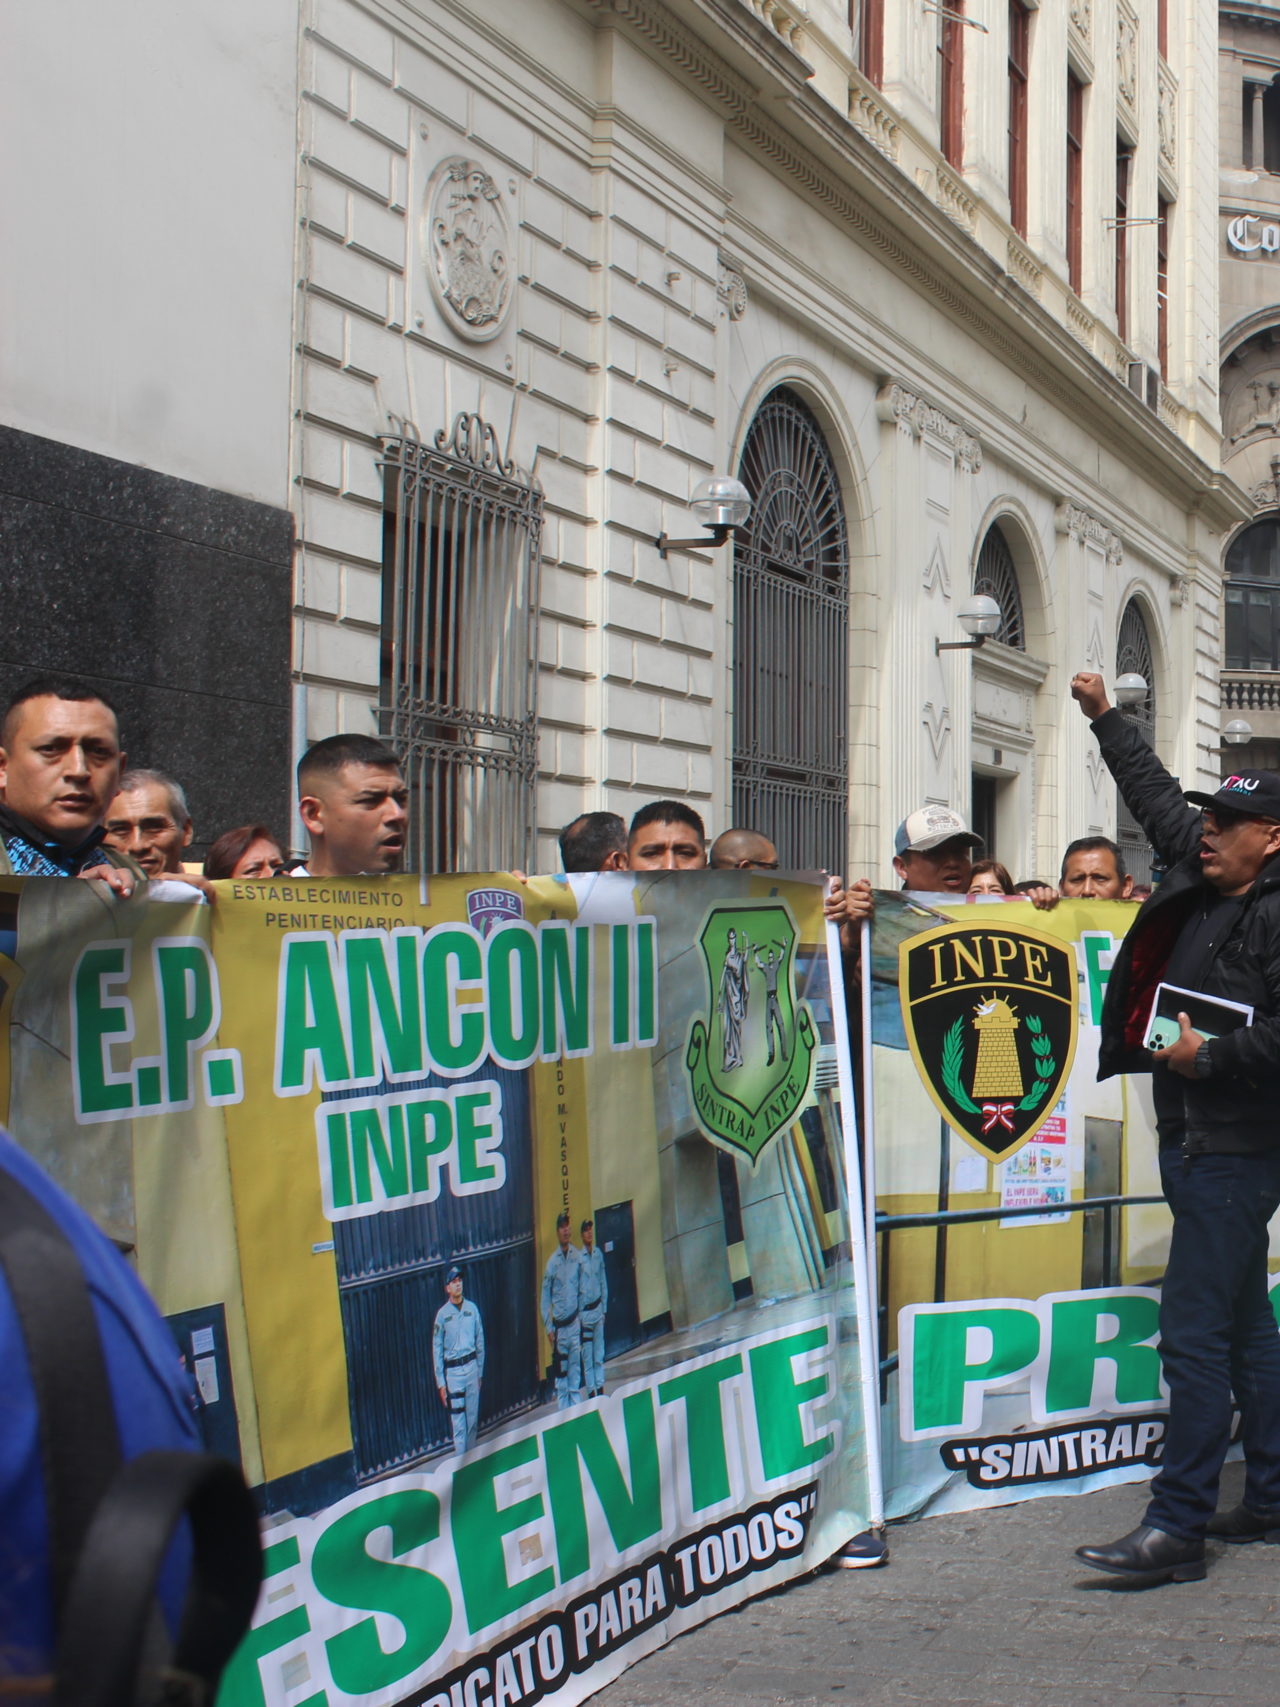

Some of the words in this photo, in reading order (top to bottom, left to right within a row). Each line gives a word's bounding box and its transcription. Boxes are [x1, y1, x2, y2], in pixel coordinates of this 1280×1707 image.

[233, 884, 403, 907] ESTABLECIMIENTO
[265, 912, 405, 931] PENITENCIARIO
[474, 893, 516, 911] INPE
[929, 935, 1053, 989] INPE
[75, 945, 236, 1114] E.P.
[280, 926, 590, 1089] ANCON
[610, 922, 655, 1044] II
[696, 1083, 756, 1142] SINTRAP
[763, 1075, 801, 1132] INPE
[326, 1091, 496, 1209] INPE
[574, 1563, 667, 1661] PARA
